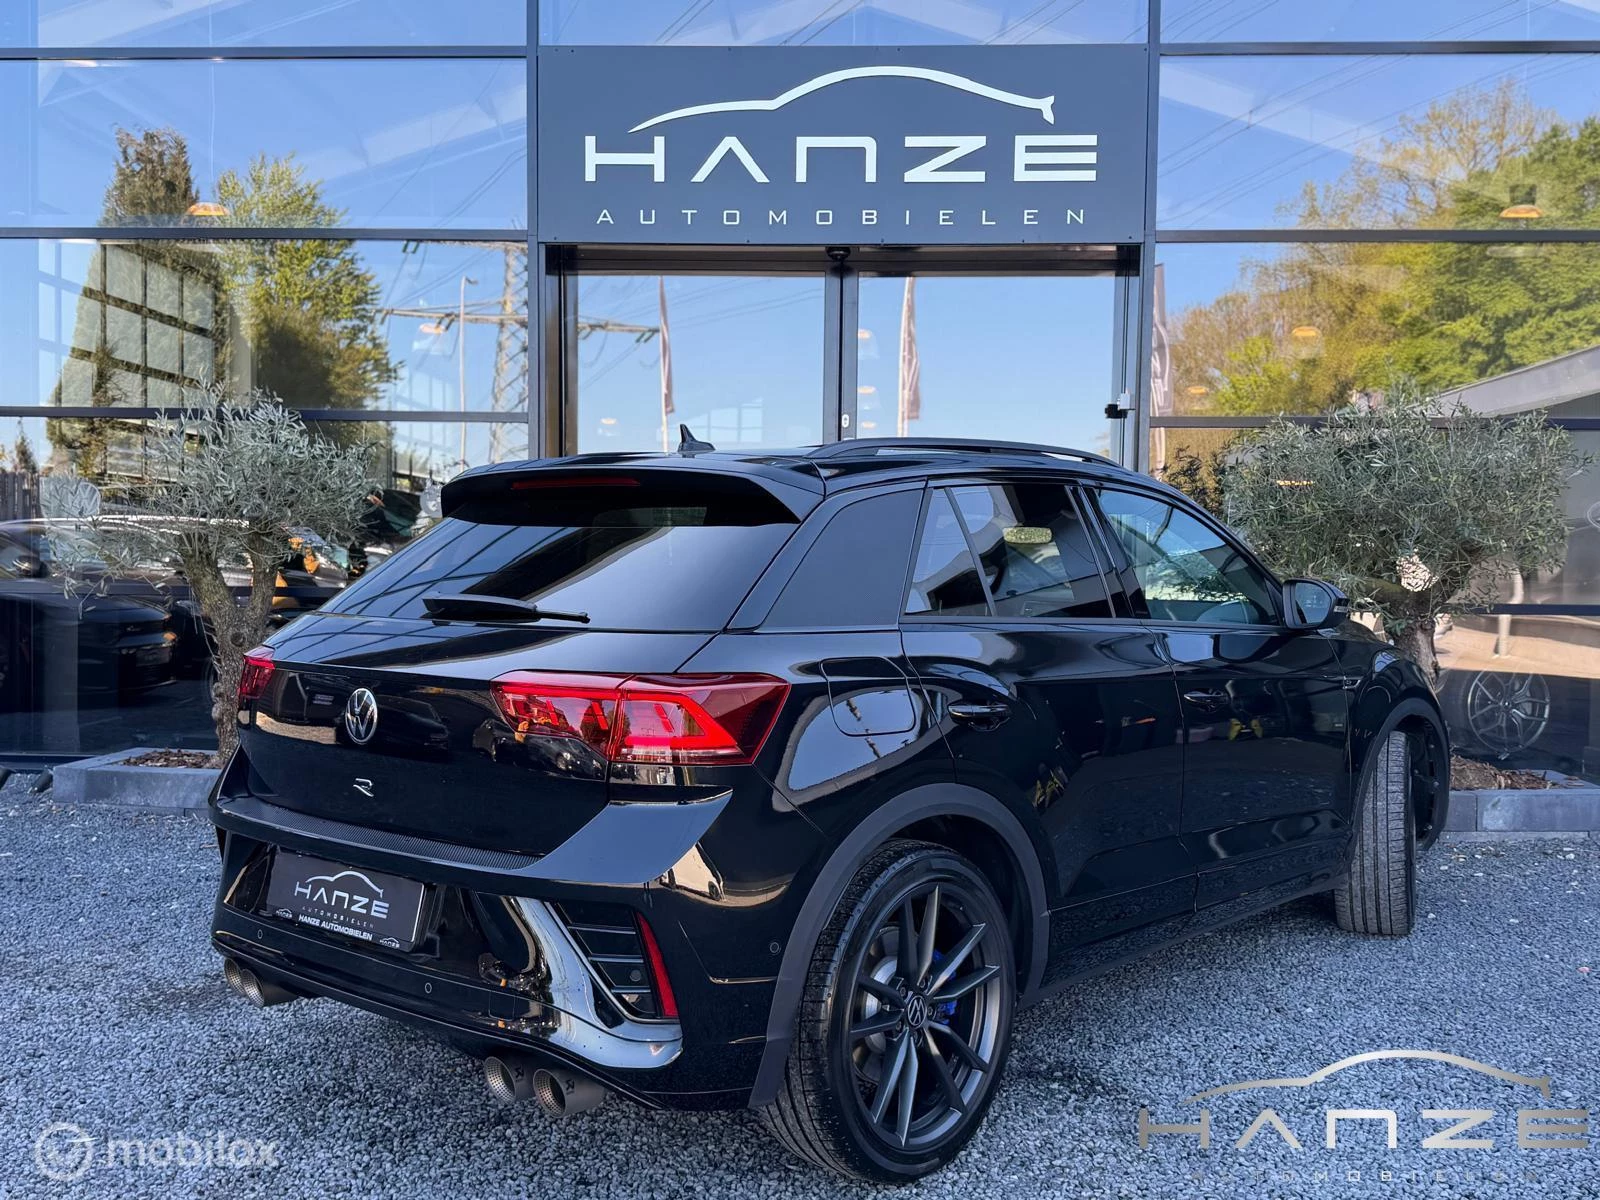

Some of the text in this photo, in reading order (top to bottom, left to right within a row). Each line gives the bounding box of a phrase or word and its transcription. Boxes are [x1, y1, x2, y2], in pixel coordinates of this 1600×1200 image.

[584, 134, 1098, 183] HANZE
[596, 208, 1085, 226] AUTOMOBIELEN
[294, 881, 390, 919] HANZE
[298, 913, 373, 941] HANZE AUTOMOBIELEN
[302, 905, 374, 929] AUTOMOBIELEN
